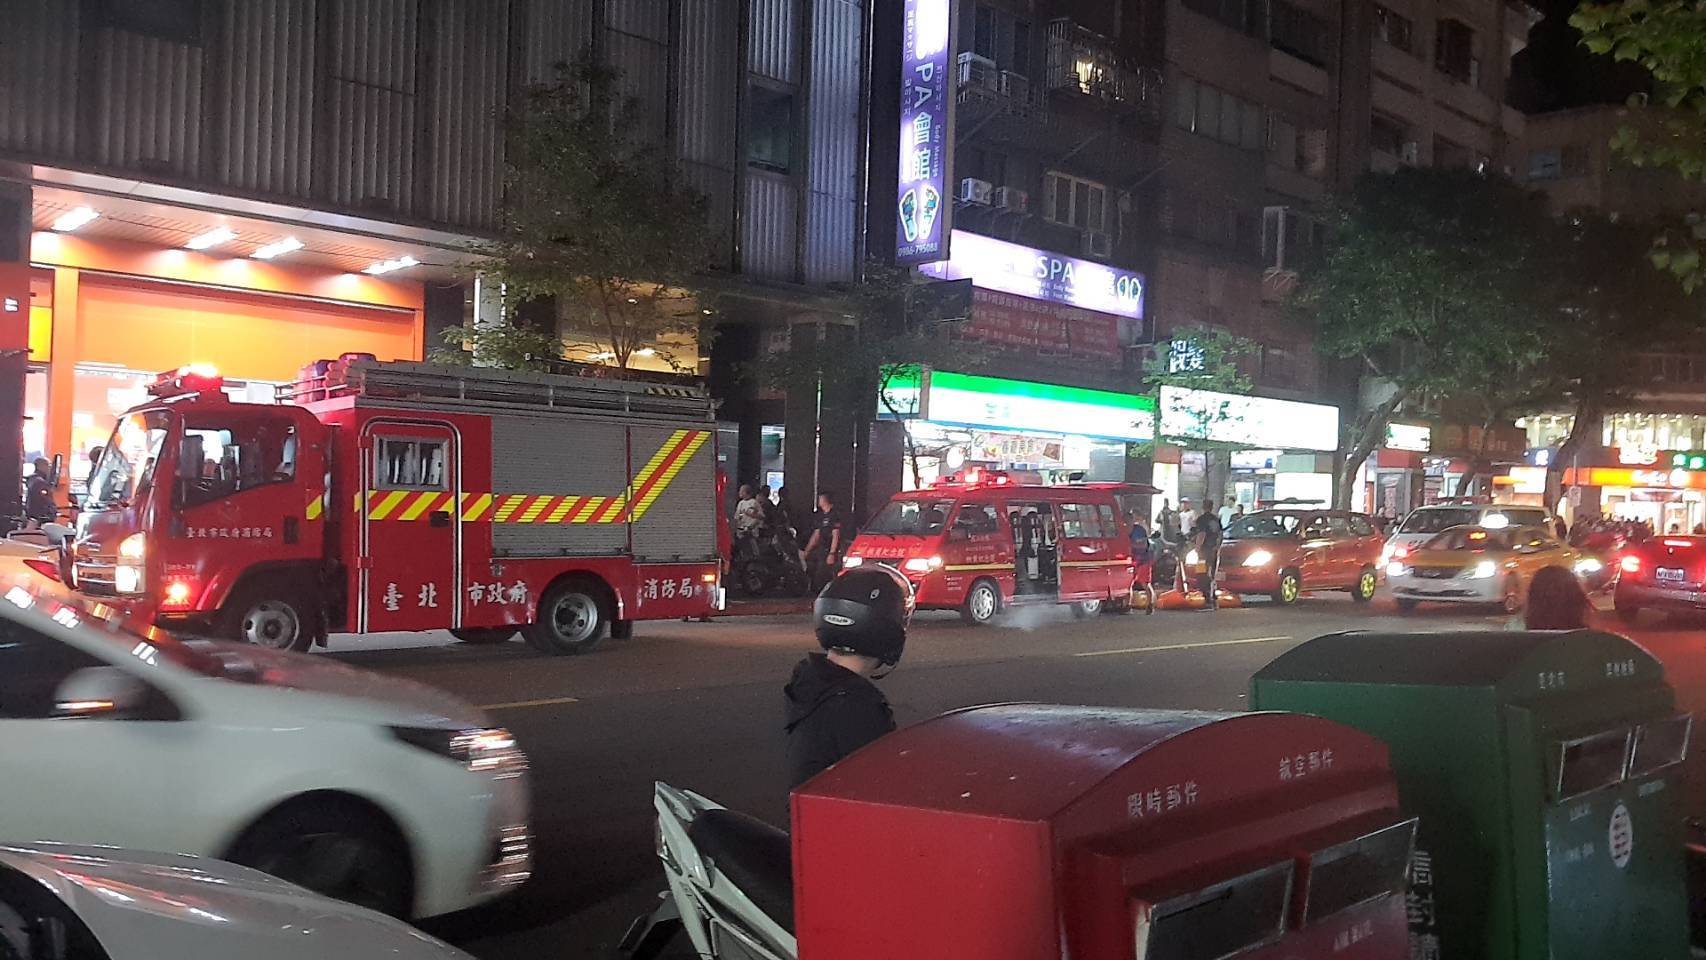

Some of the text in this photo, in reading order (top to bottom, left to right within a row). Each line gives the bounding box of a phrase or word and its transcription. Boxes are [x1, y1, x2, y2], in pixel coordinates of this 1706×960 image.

[1037, 255, 1073, 282] SPA
[382, 578, 693, 611] 臺北 市政府 消防局
[1279, 748, 1335, 780] 航空郵件
[1127, 780, 1200, 817] 限時郵件
